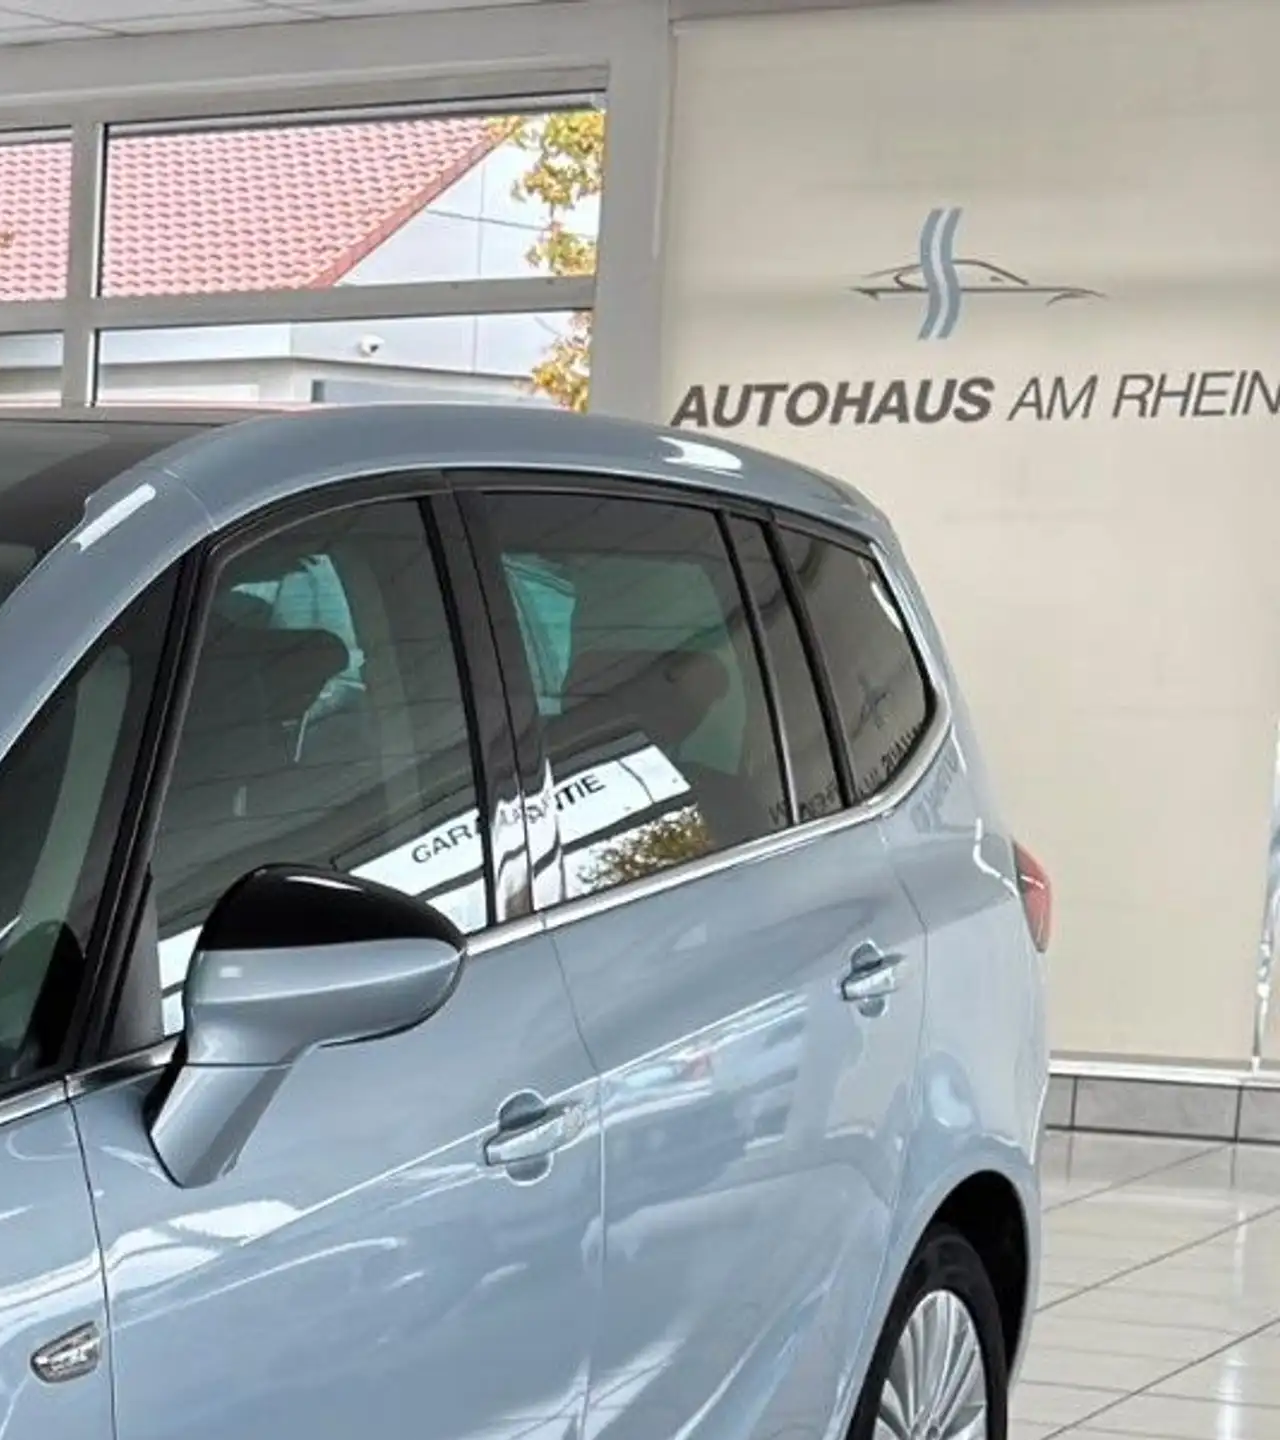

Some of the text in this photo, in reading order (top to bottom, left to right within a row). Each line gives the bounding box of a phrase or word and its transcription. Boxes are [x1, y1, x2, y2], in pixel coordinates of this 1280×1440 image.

[670, 369, 1280, 428] AUTOHAUS AM RHEIN
